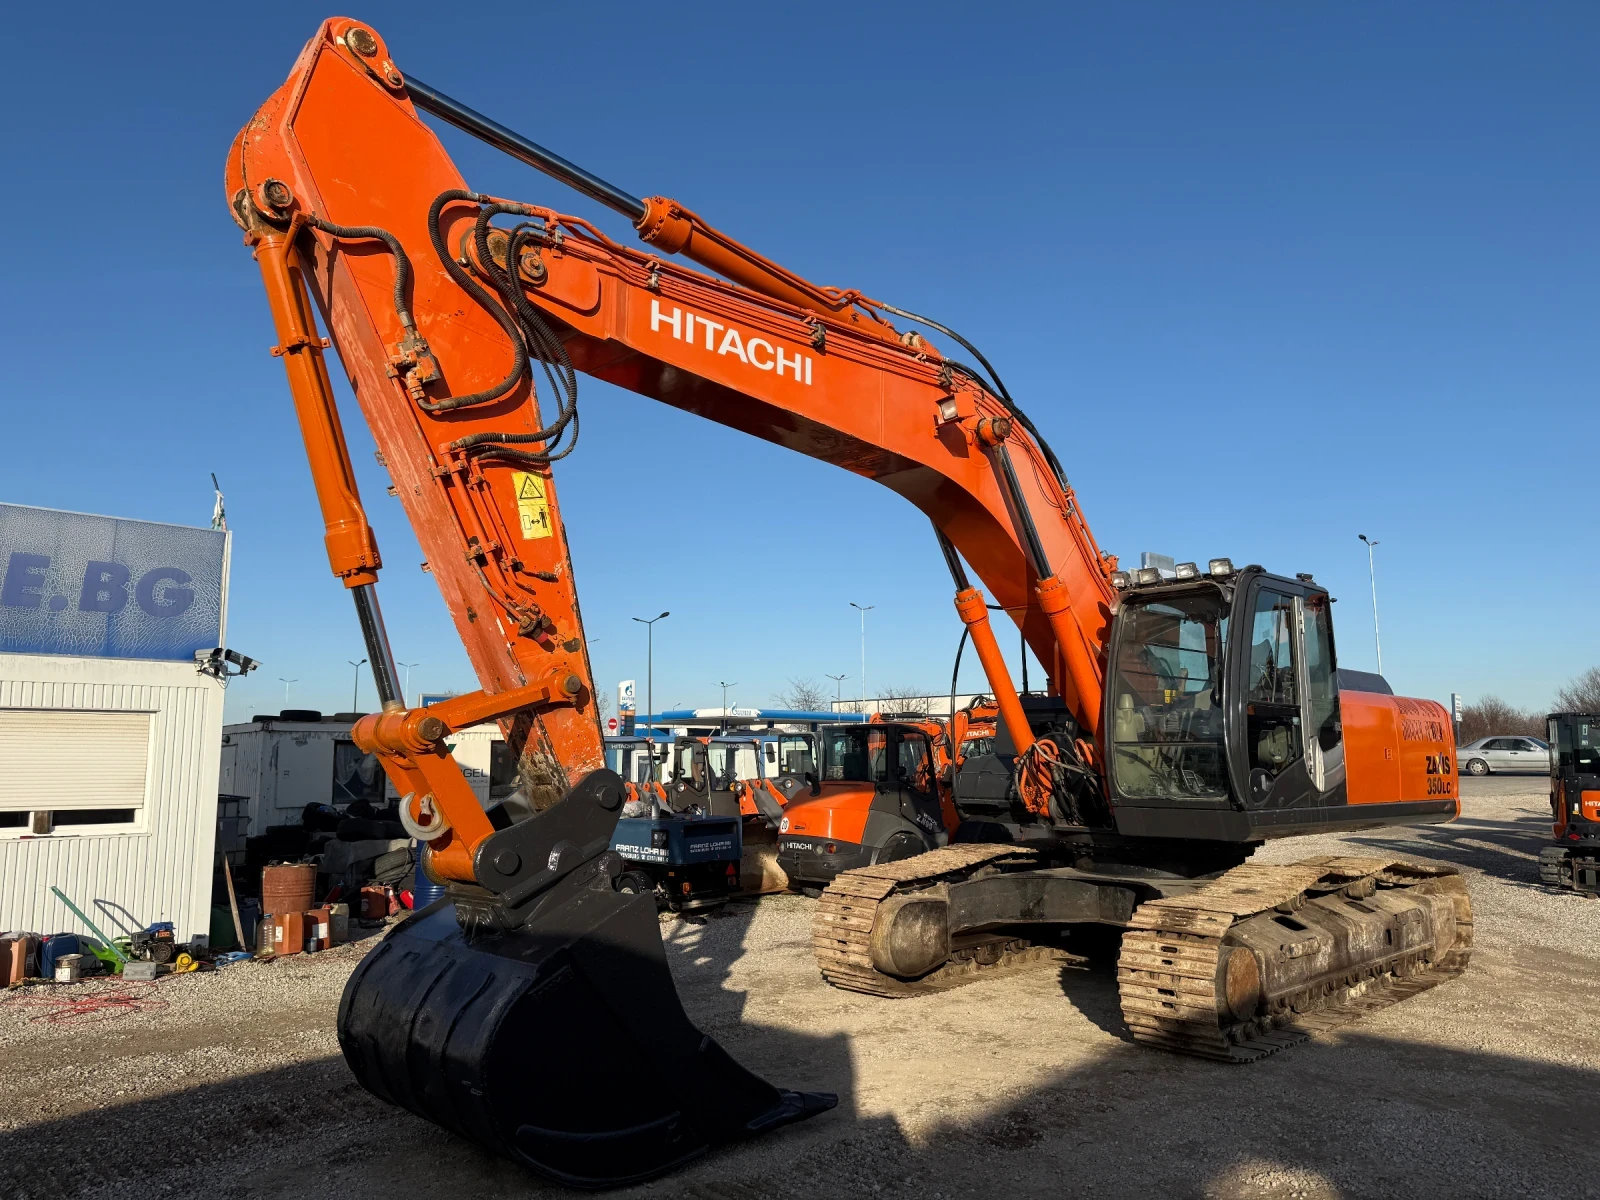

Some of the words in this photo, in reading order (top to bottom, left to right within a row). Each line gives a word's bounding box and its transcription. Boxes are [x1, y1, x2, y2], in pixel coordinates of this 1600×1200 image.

[650, 299, 812, 386] HITACHI
[1426, 752, 1450, 774] ZAXIS
[460, 768, 488, 777] GEL
[1427, 776, 1451, 795] 350LC
[615, 844, 639, 853] FRANZ
[640, 847, 660, 855] LOHR
[786, 842, 812, 850] HITACHI
